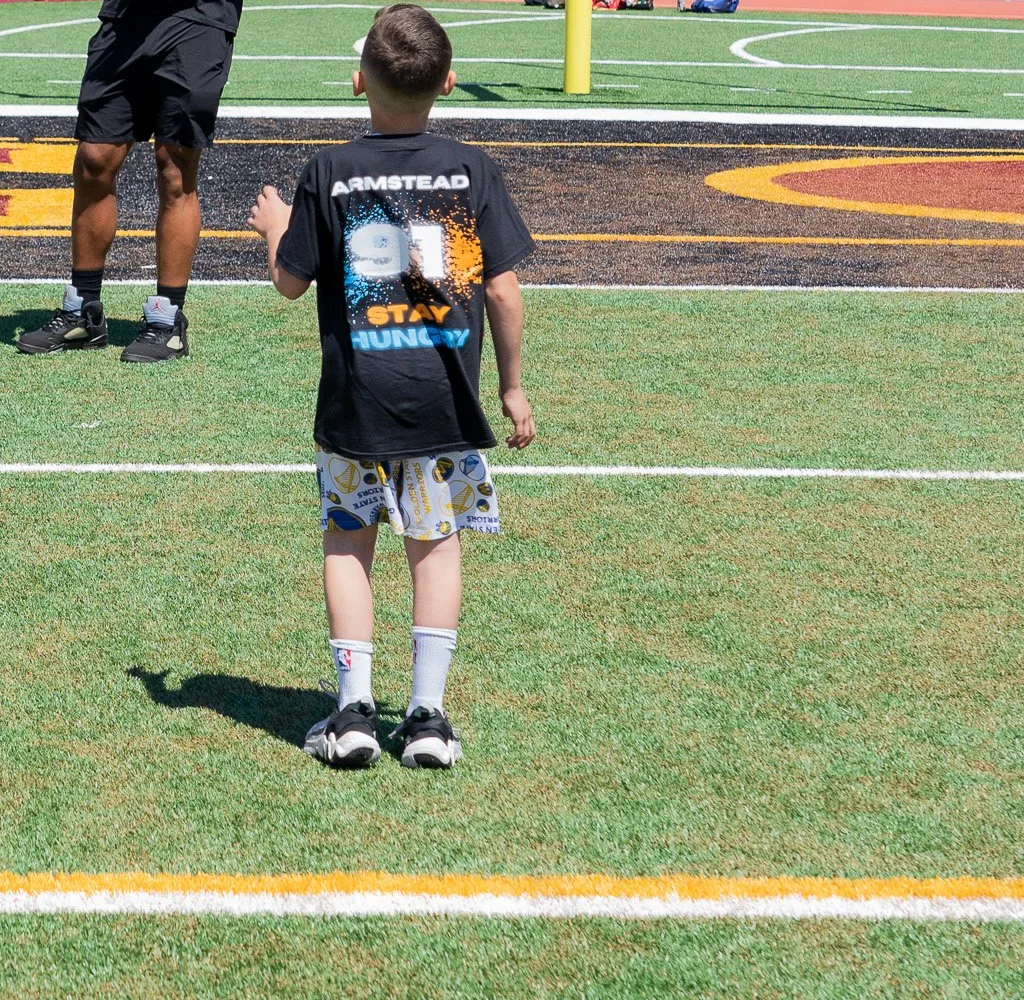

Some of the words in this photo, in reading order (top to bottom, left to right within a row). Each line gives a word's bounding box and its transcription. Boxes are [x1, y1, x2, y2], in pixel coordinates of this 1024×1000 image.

[331, 175, 470, 197] ARMSTEAD
[350, 222, 444, 279] 91
[367, 304, 451, 325] STAY
[357, 486, 384, 499] RIORS
[412, 462, 432, 515] WARRIORS
[466, 515, 498, 523] RRIORS
